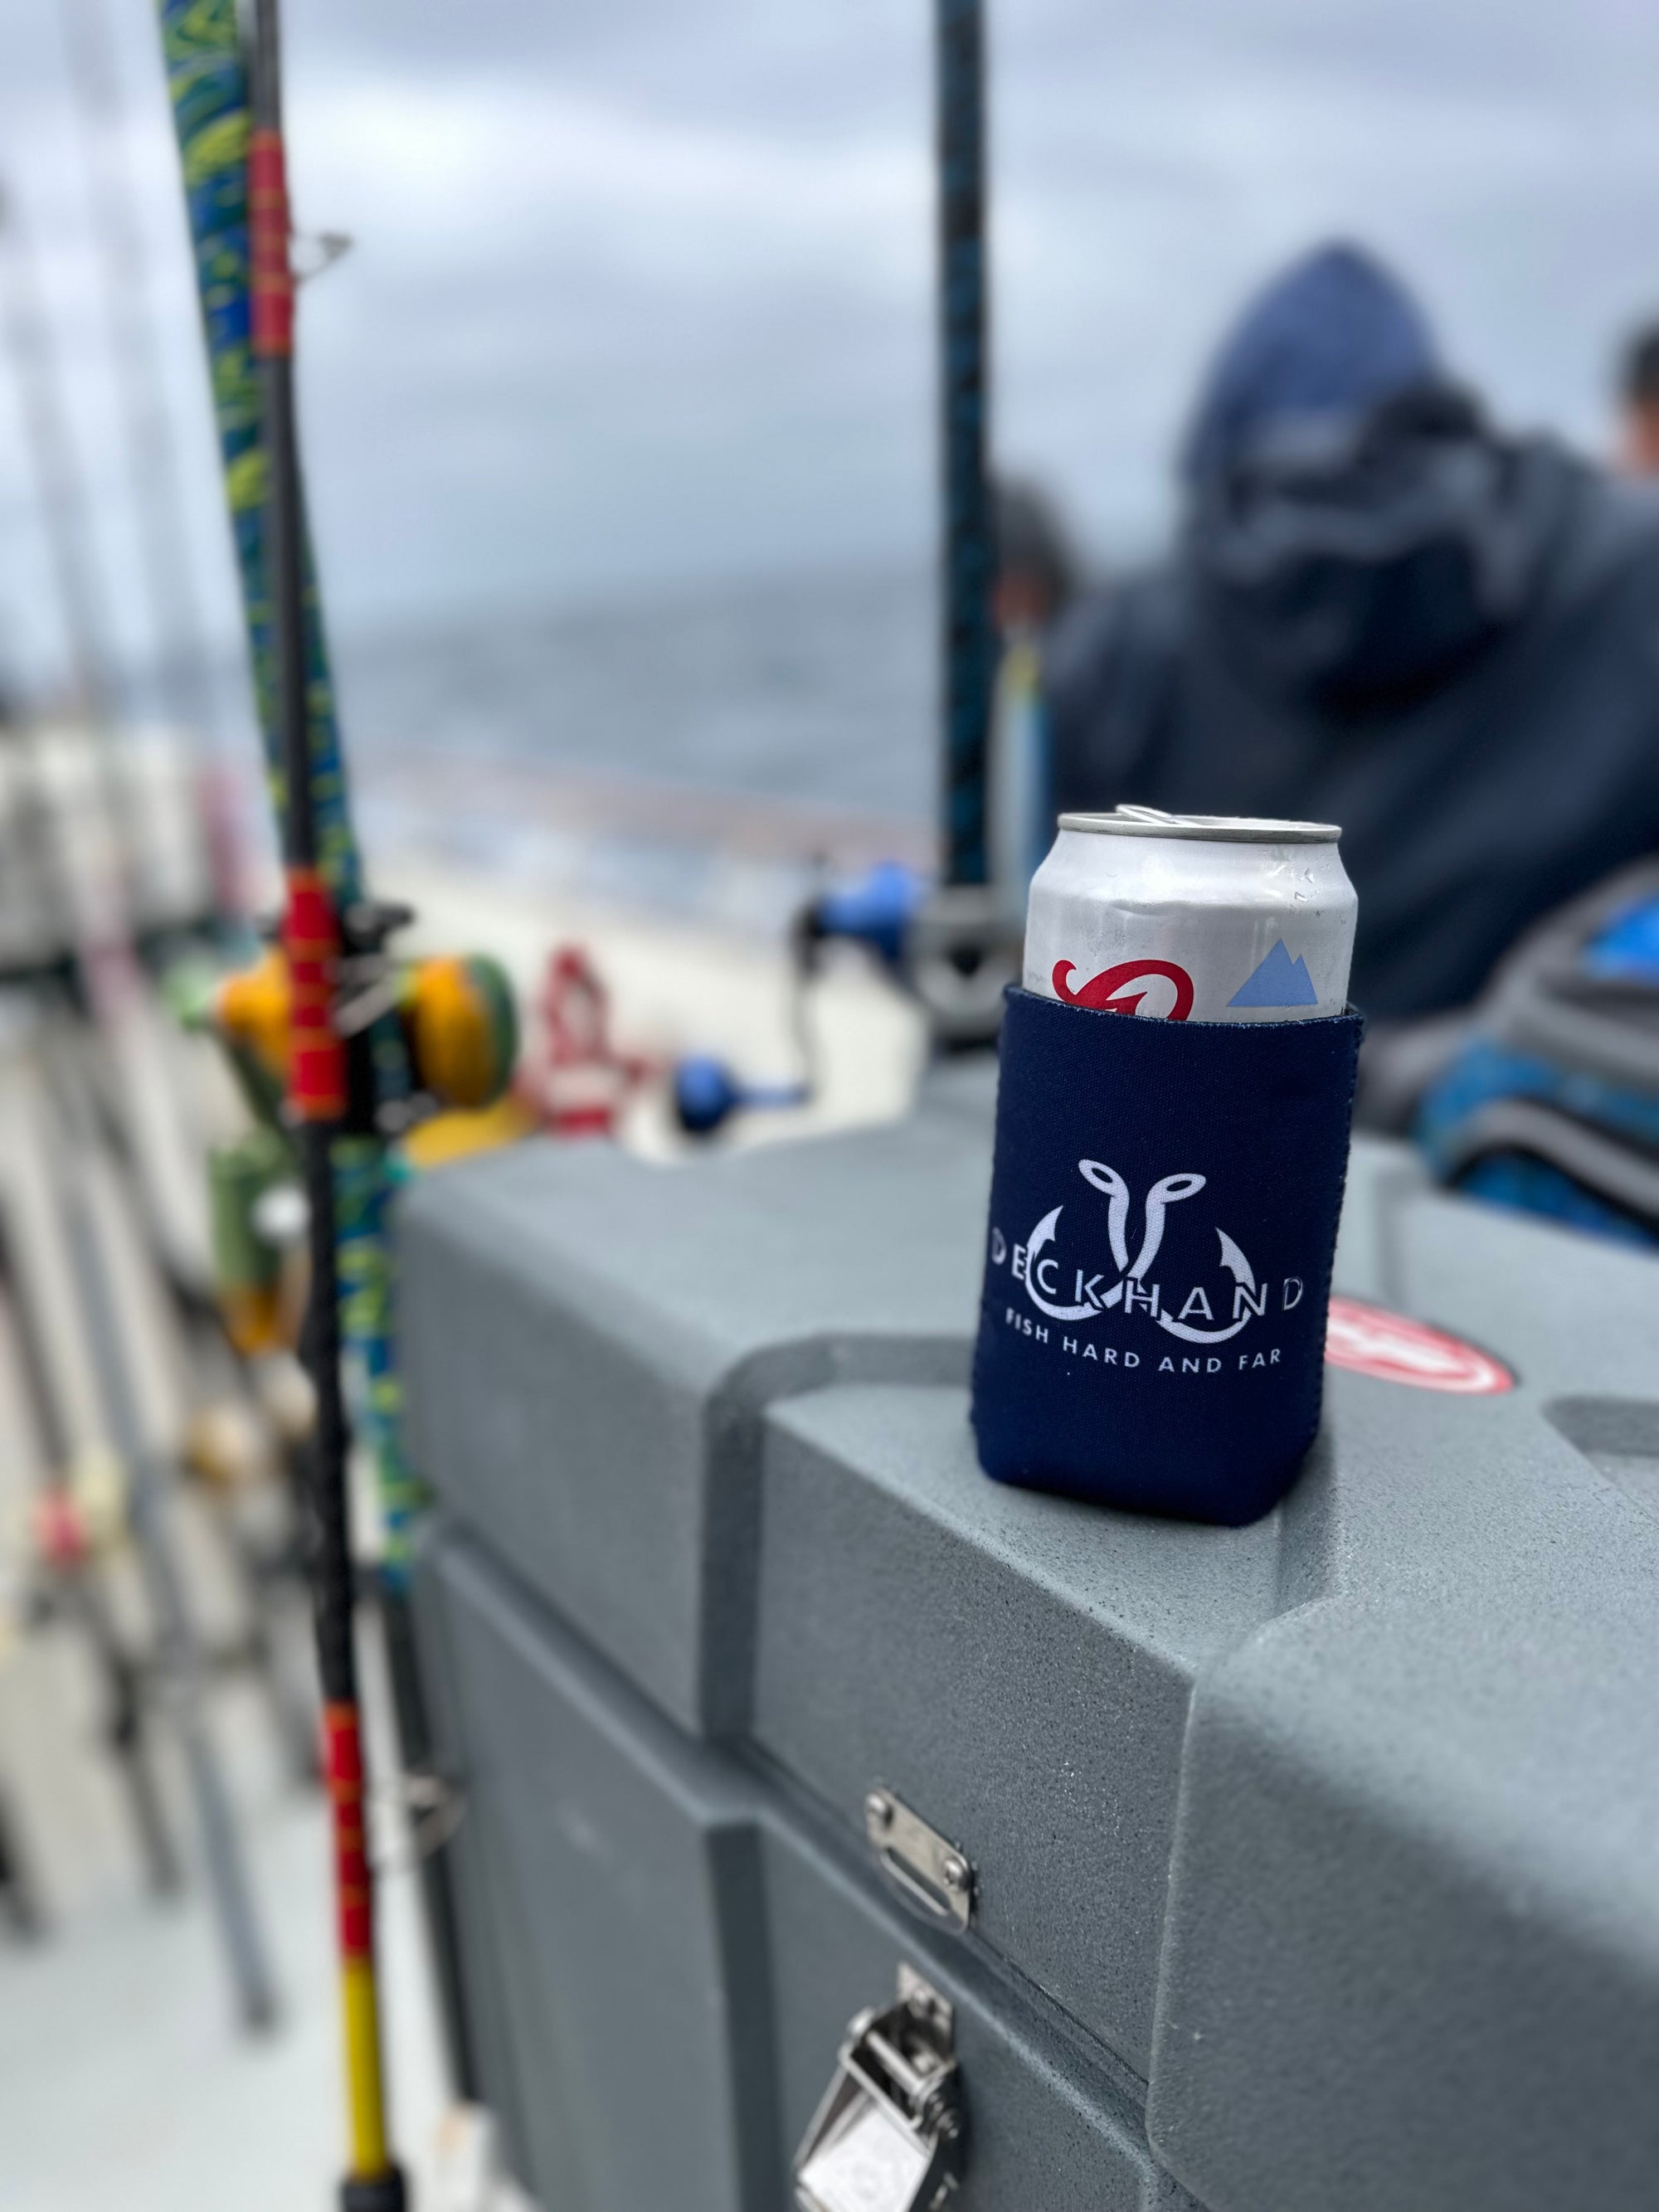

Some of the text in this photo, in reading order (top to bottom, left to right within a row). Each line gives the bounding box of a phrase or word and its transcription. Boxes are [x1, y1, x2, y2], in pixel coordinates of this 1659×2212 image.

[990, 1228, 1303, 1320] DECKHAND
[1006, 1307, 1282, 1373] FISH HARD AND FAR
